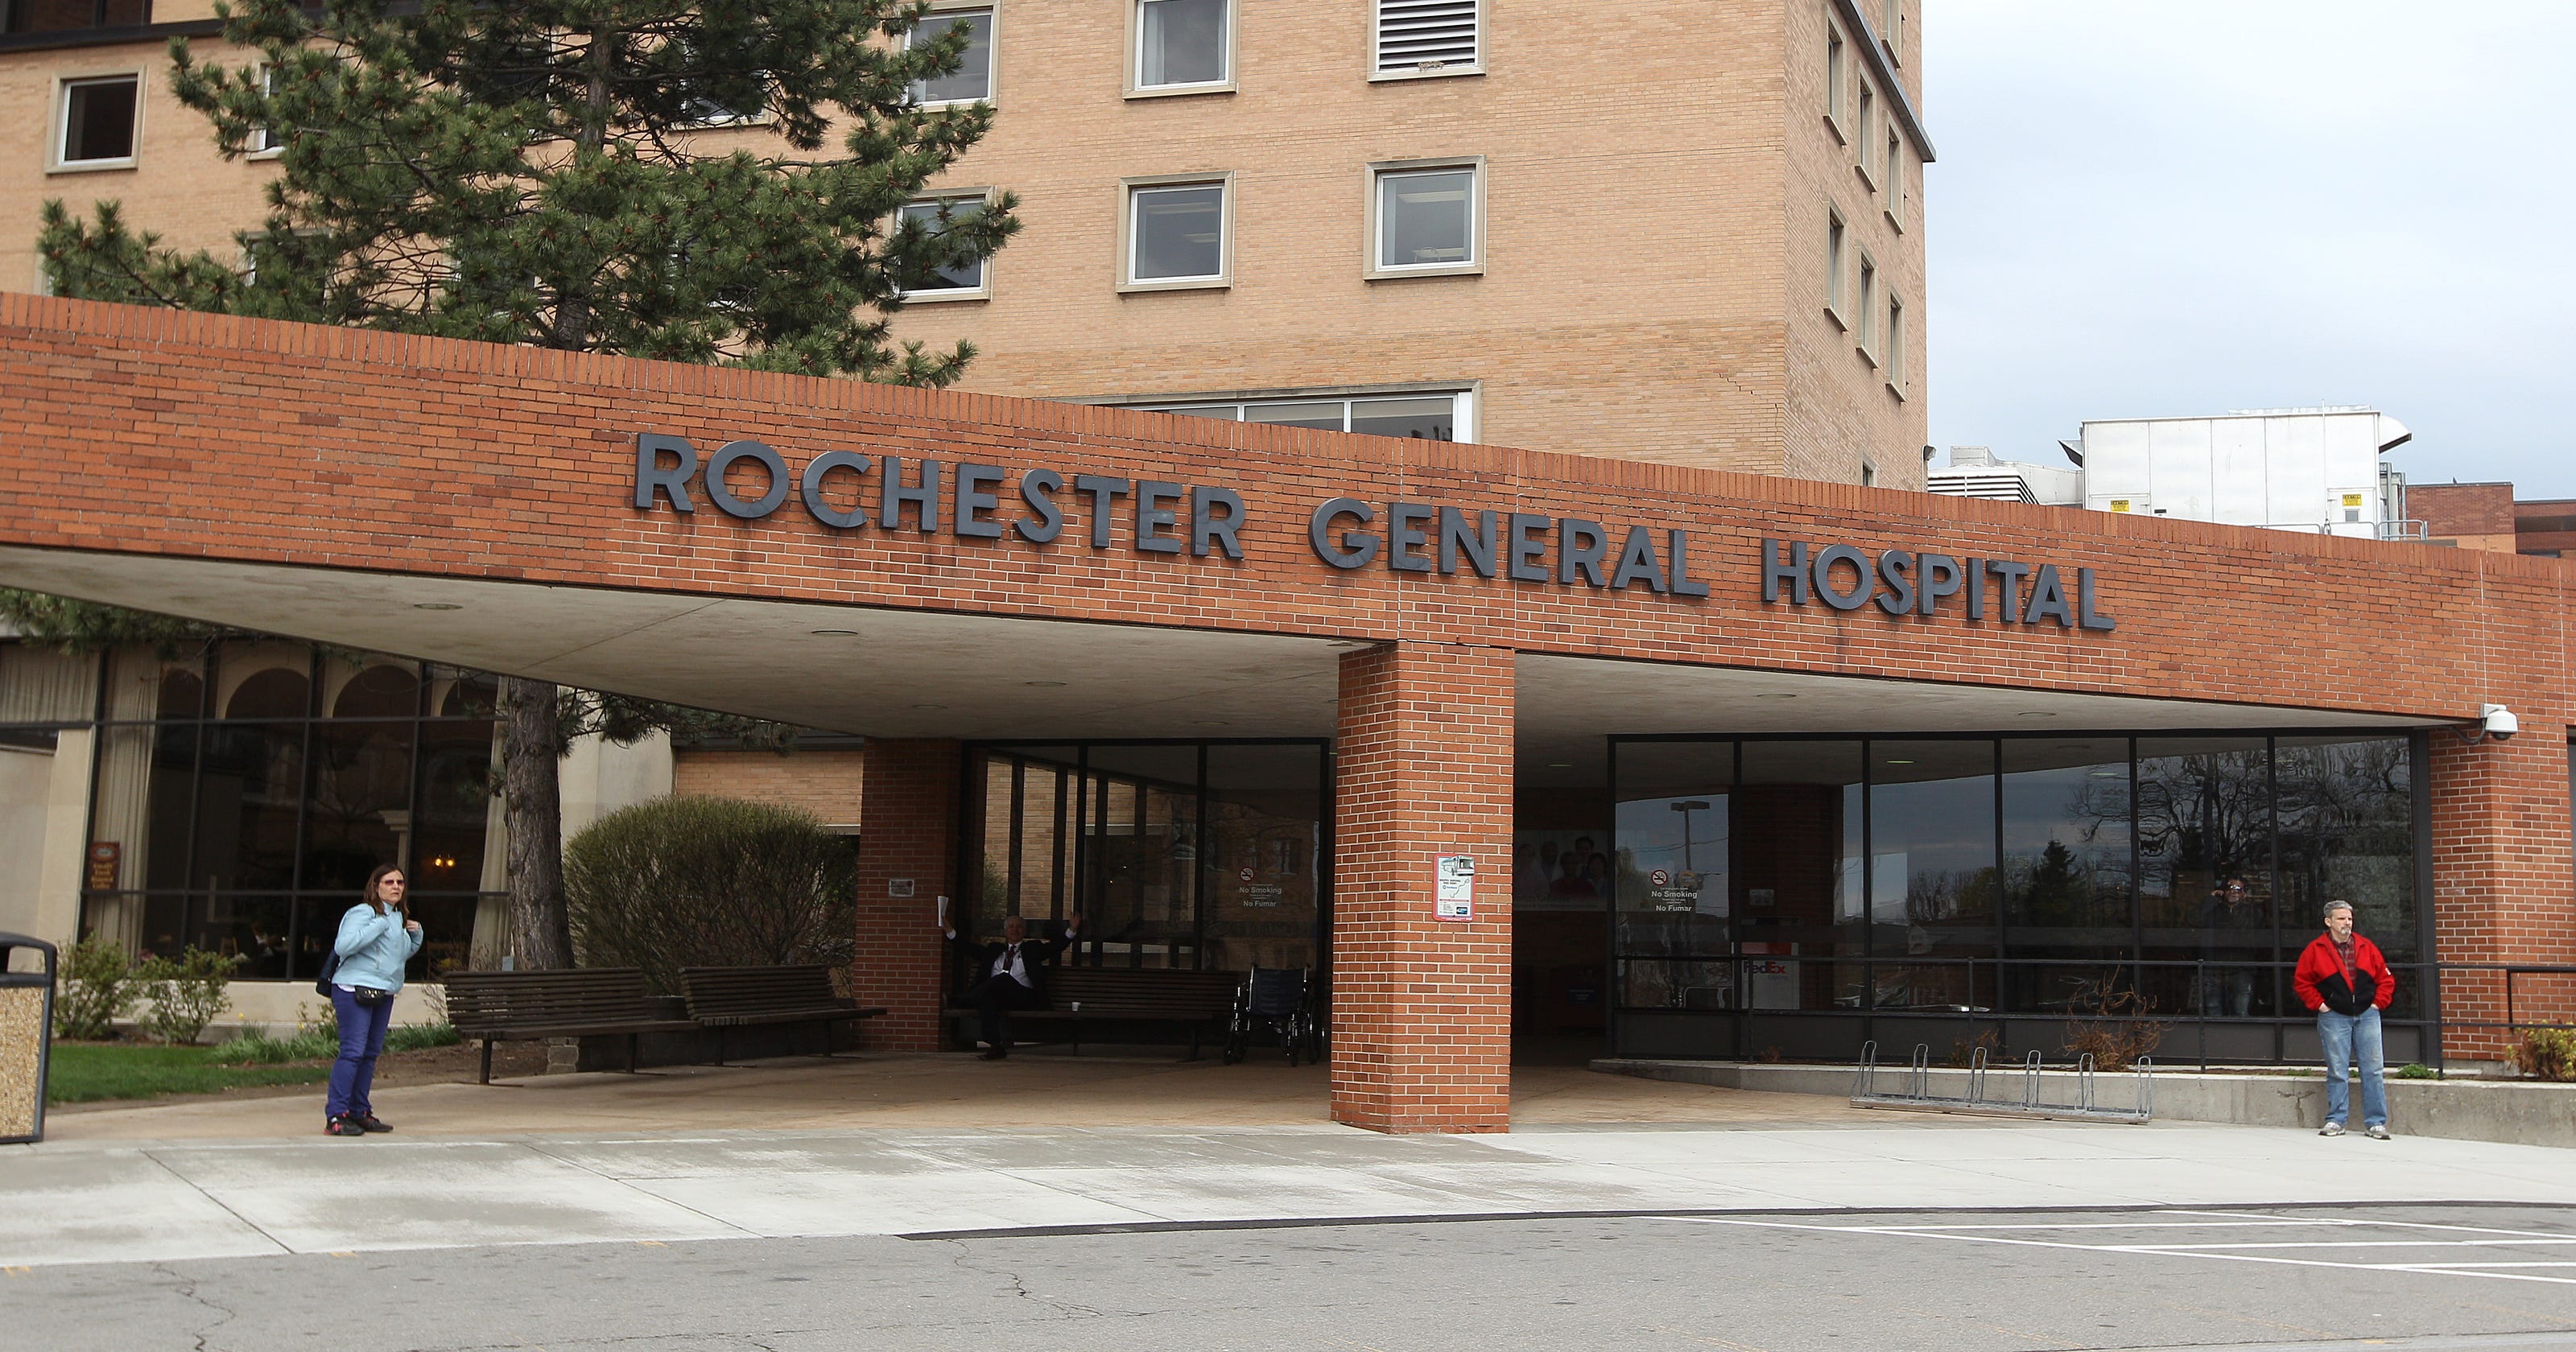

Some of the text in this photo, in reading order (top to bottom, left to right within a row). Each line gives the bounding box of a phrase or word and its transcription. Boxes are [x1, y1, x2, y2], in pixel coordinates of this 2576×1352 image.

[634, 433, 2116, 632] ROCHESTER GENERAL HOSPITAL
[1664, 890, 1697, 898] Smoking
